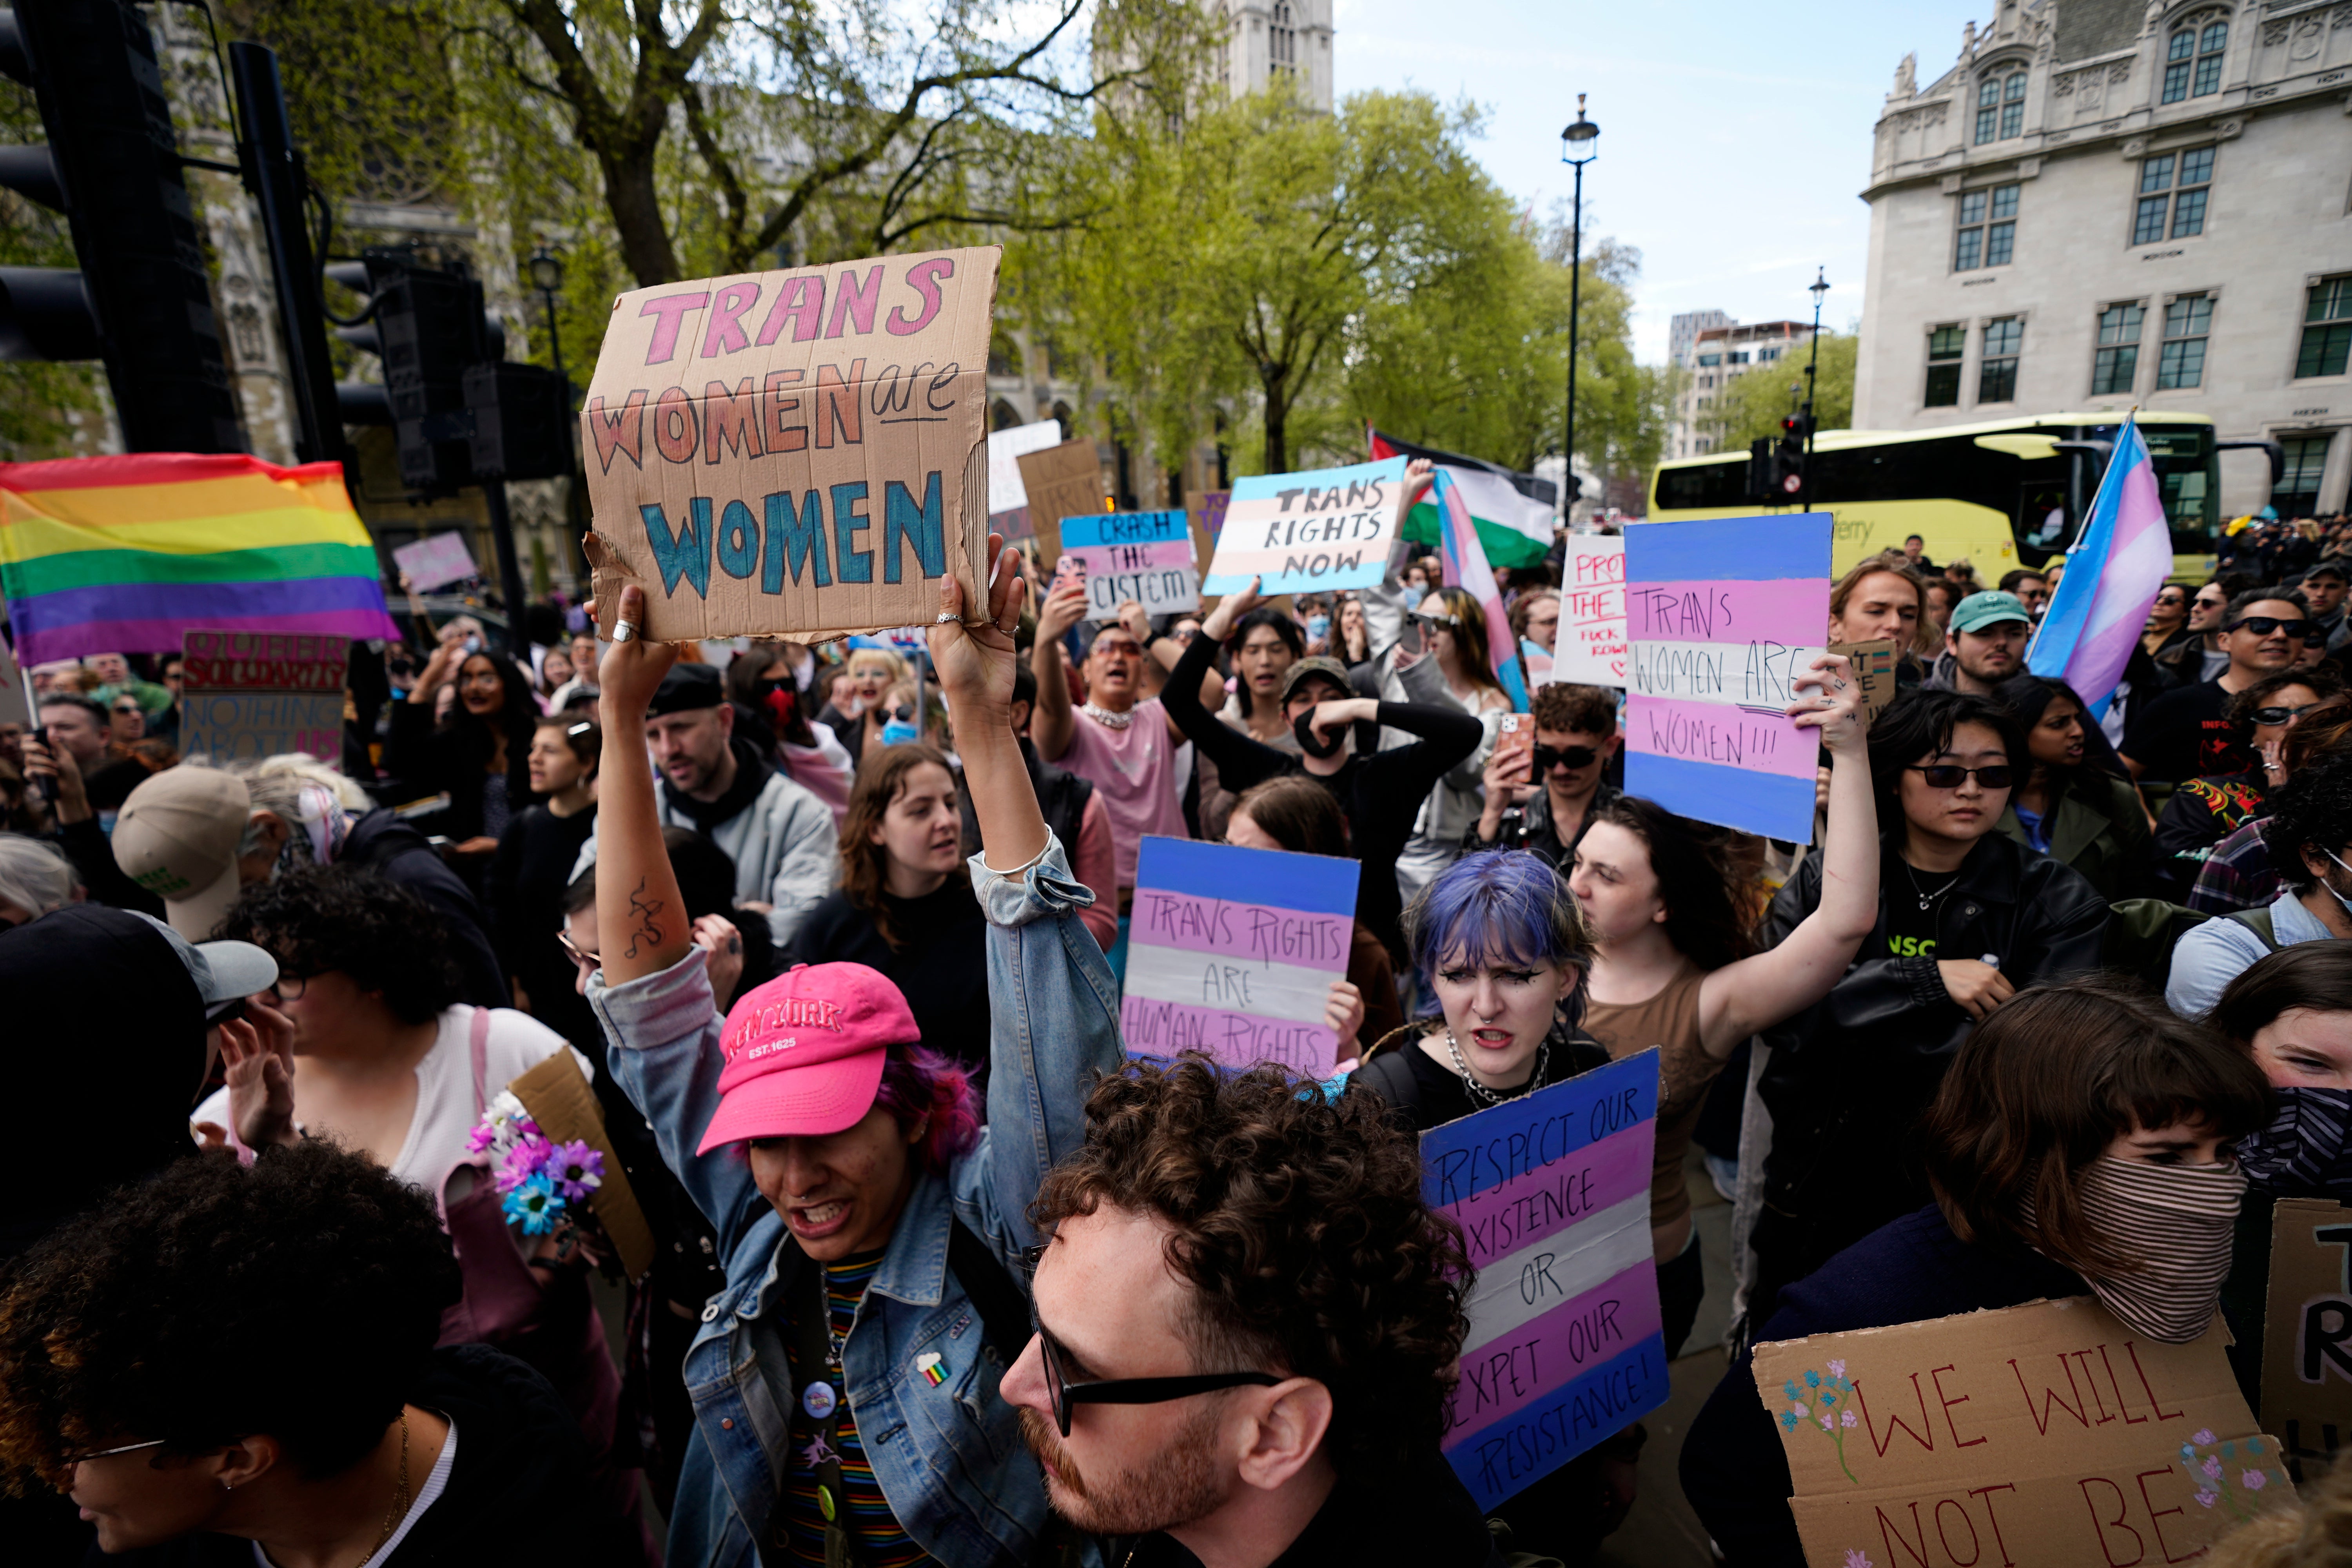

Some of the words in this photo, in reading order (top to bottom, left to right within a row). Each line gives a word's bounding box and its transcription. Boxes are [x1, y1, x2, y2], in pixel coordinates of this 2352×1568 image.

[639, 258, 955, 366] TRANS
[589, 358, 867, 476] WOMEN
[871, 361, 960, 416] are
[1276, 475, 1386, 513] TRANS
[639, 471, 947, 600] WOMEN
[1098, 513, 1171, 544] CRASH
[1264, 511, 1382, 548] RIGHTS
[1281, 549, 1362, 579] NOW
[1093, 570, 1186, 609] CISTEM
[1565, 590, 1615, 619] THE
[1632, 588, 1731, 638] TRANS
[186, 632, 347, 663] QUEER
[1581, 628, 1619, 641] FUCK
[1635, 644, 1722, 694] WOMEN
[1746, 640, 1805, 701] ARE
[183, 695, 342, 731] NOTHING
[296, 729, 340, 760] US
[1145, 895, 1233, 945] TRANS
[1247, 908, 1341, 970] RIGHTS
[1203, 963, 1252, 1008] ARE
[767, 998, 843, 1033] YORK
[1125, 996, 1207, 1051] HUMAN
[1221, 1014, 1322, 1070] RIGHTS
[1433, 1112, 1574, 1216] RESPECT
[1590, 1088, 1637, 1142] OUR
[1520, 1253, 1563, 1305] OR
[1569, 1299, 1623, 1364] OUR
[1474, 1353, 1648, 1494] RESISTANCE!
[1852, 1364, 1987, 1457] WE
[2007, 1341, 2184, 1436] WILL
[1874, 1483, 2015, 1568] NOT
[2078, 1465, 2210, 1568] BE
